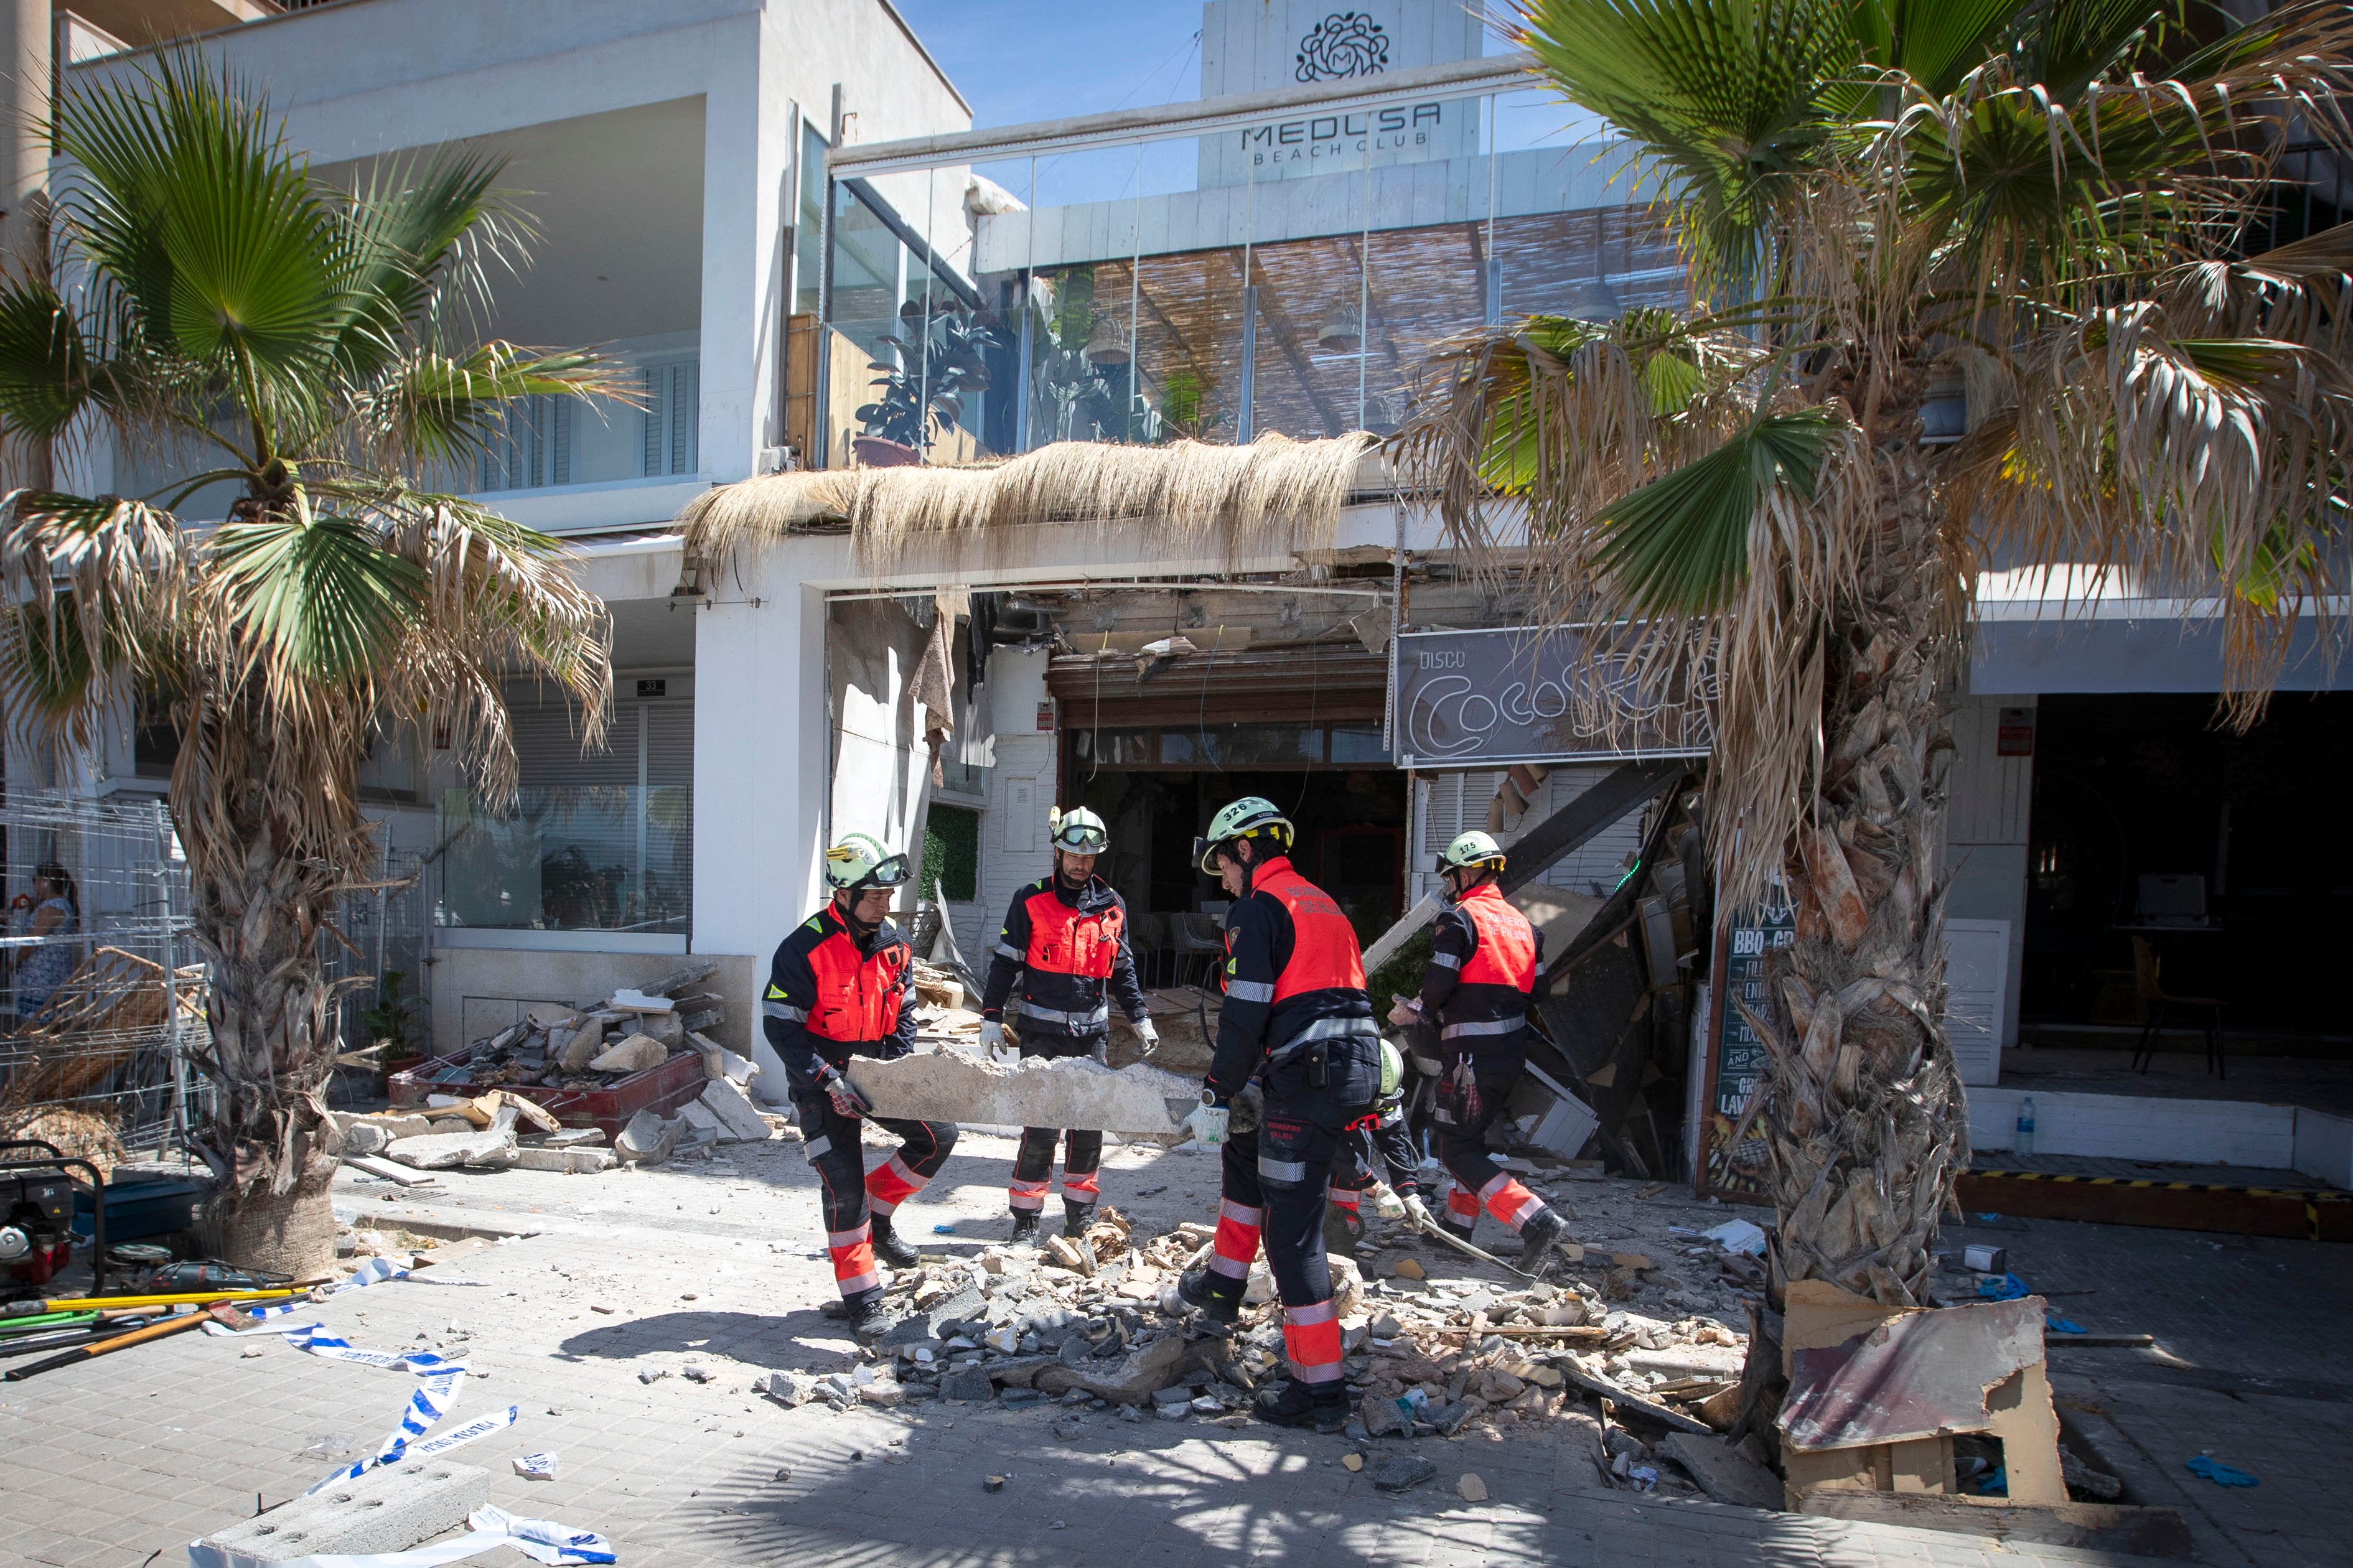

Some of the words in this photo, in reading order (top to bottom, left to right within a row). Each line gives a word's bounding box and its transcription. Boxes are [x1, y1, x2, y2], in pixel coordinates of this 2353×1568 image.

[1254, 142, 1341, 166] BEACH
[1357, 131, 1427, 152] CLUB
[1420, 650, 1466, 670] DISCO
[646, 680, 657, 690] 33
[1223, 803, 1247, 822] 326
[1459, 841, 1476, 855] 175
[1484, 911, 1525, 928] BOMBERS
[1487, 923, 1500, 935] DE
[1501, 926, 1529, 941] PALMA
[1733, 930, 1764, 956] BBQ
[1728, 1052, 1749, 1066] AND
[1267, 1121, 1302, 1133] BOMBERS
